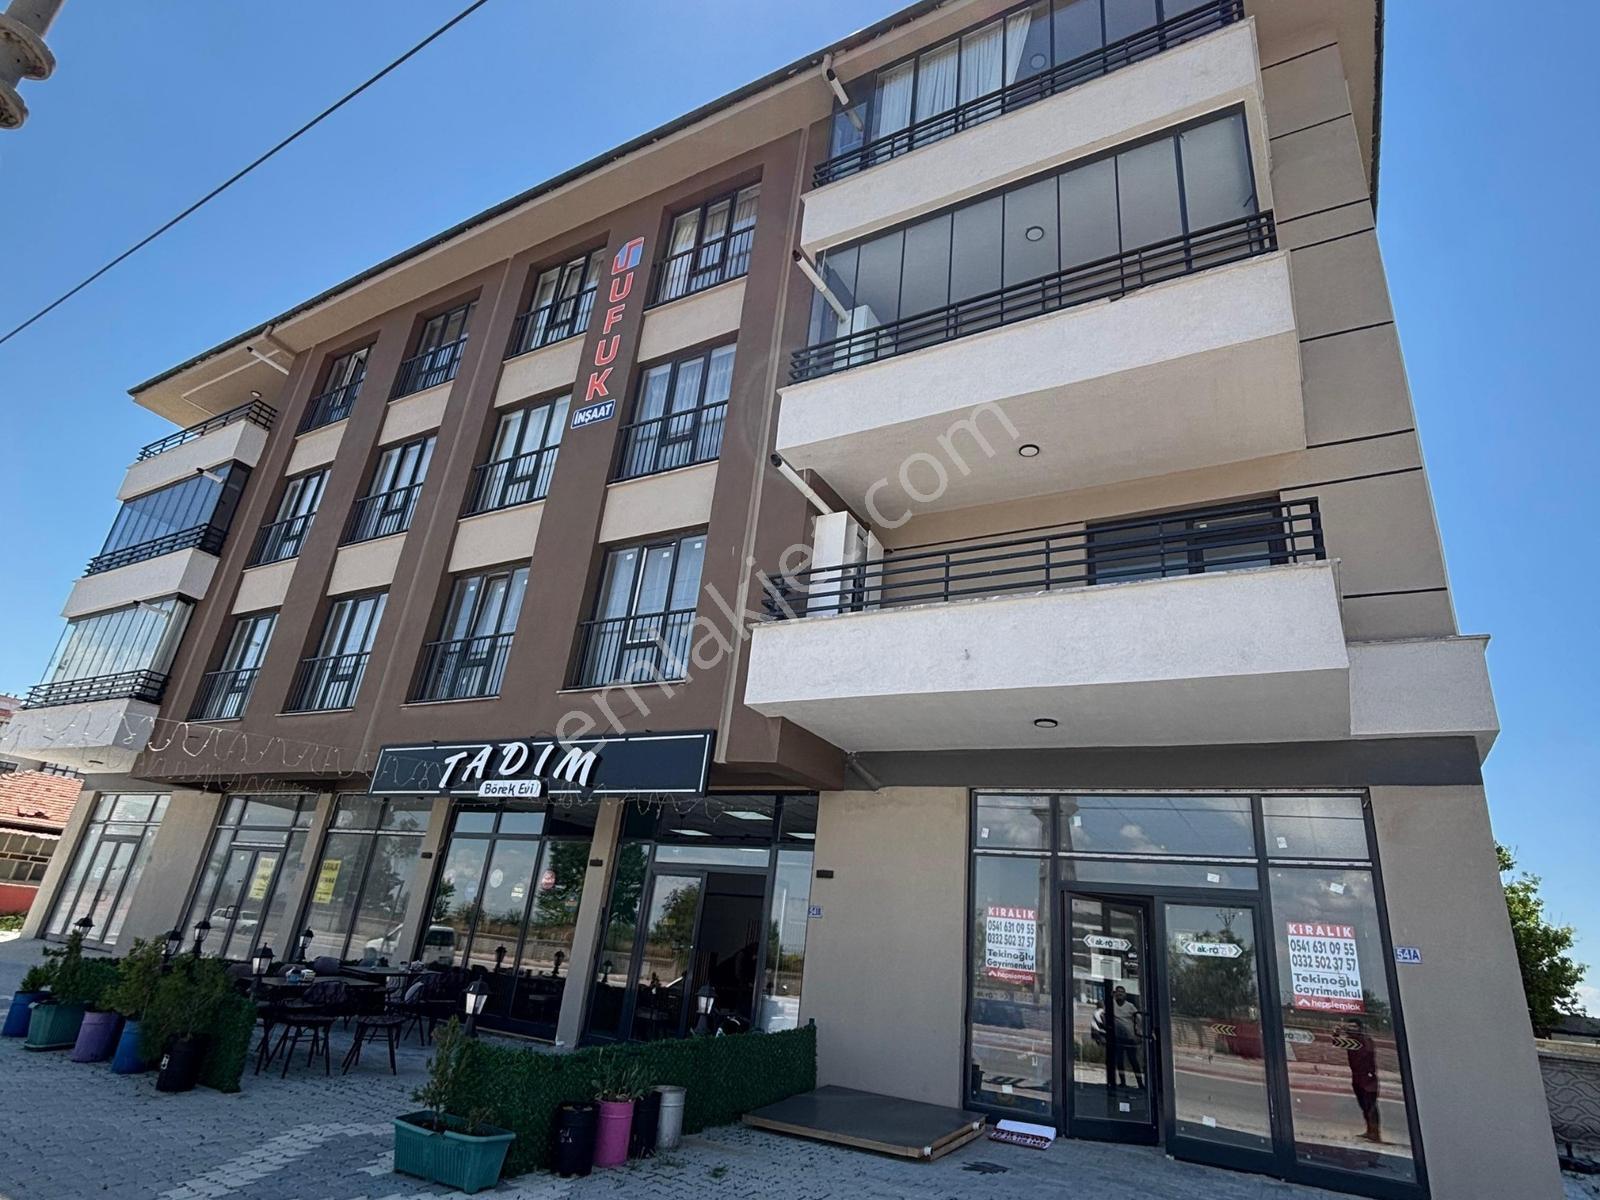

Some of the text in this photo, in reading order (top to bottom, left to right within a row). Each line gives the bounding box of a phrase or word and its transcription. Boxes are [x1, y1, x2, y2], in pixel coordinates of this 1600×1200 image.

[585, 272, 633, 402] UFUK
[574, 403, 612, 425] İNŞAAT
[438, 742, 597, 788] TADIM
[518, 783, 535, 795] Evi
[988, 920, 1035, 935] 0541 631 09 55
[988, 933, 1035, 948] 0332 502 37 57
[1290, 939, 1354, 956] 0541 631 09 55
[987, 949, 1034, 961] Tekinoğlu
[1292, 954, 1356, 971] 0332 502 37 57
[987, 958, 1034, 970] Gayrimenkul
[1294, 973, 1358, 987] Tekinoğlu
[1295, 984, 1360, 998] Gayrimenkul
